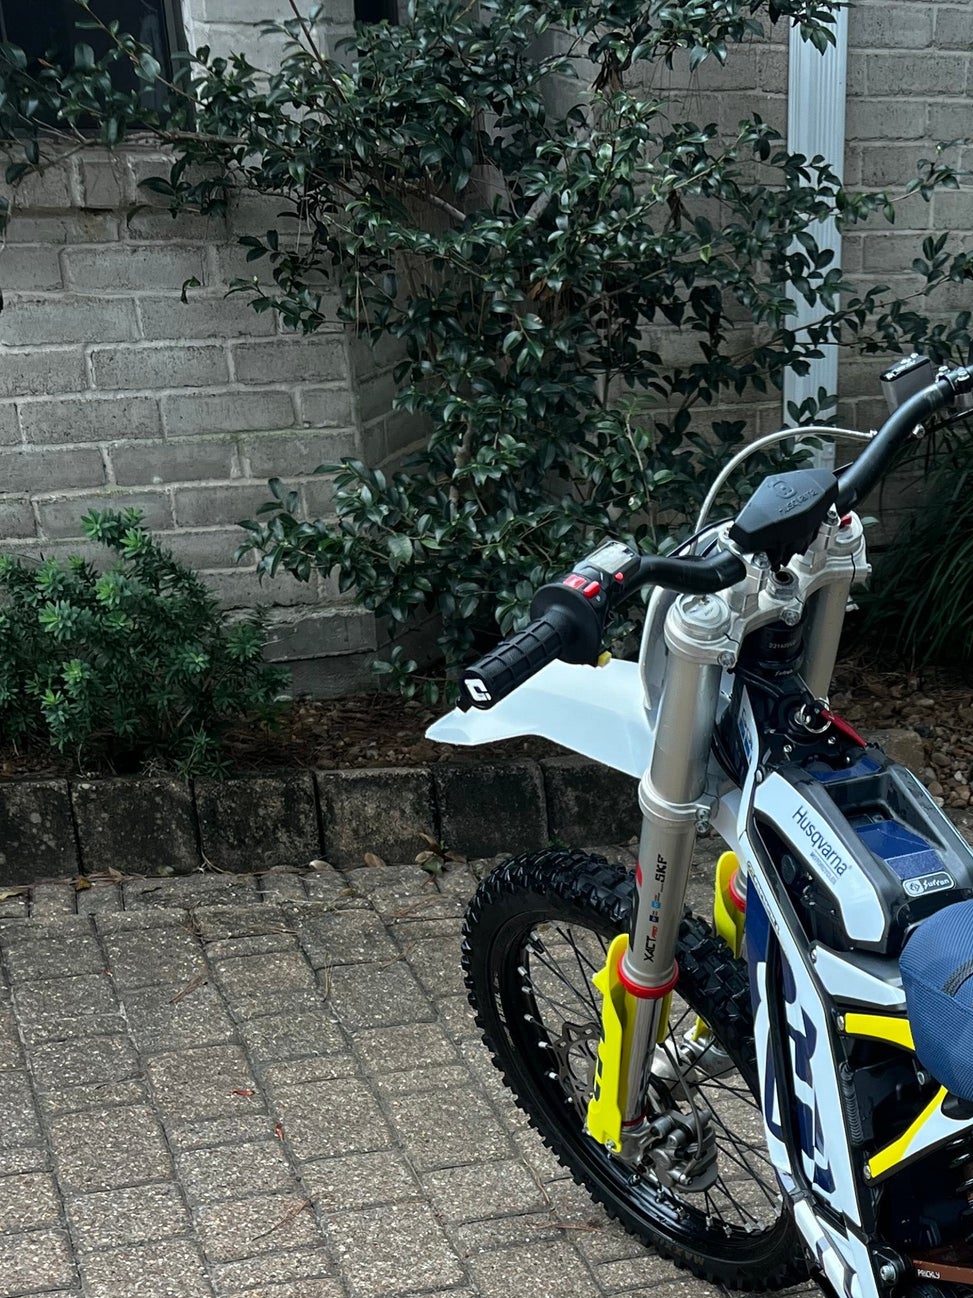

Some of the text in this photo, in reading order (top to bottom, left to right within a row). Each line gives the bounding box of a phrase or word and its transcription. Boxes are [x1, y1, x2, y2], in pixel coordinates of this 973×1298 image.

[792, 806, 849, 877] Husqvarna
[654, 853, 668, 883] SKF
[643, 934, 658, 963] XACT
